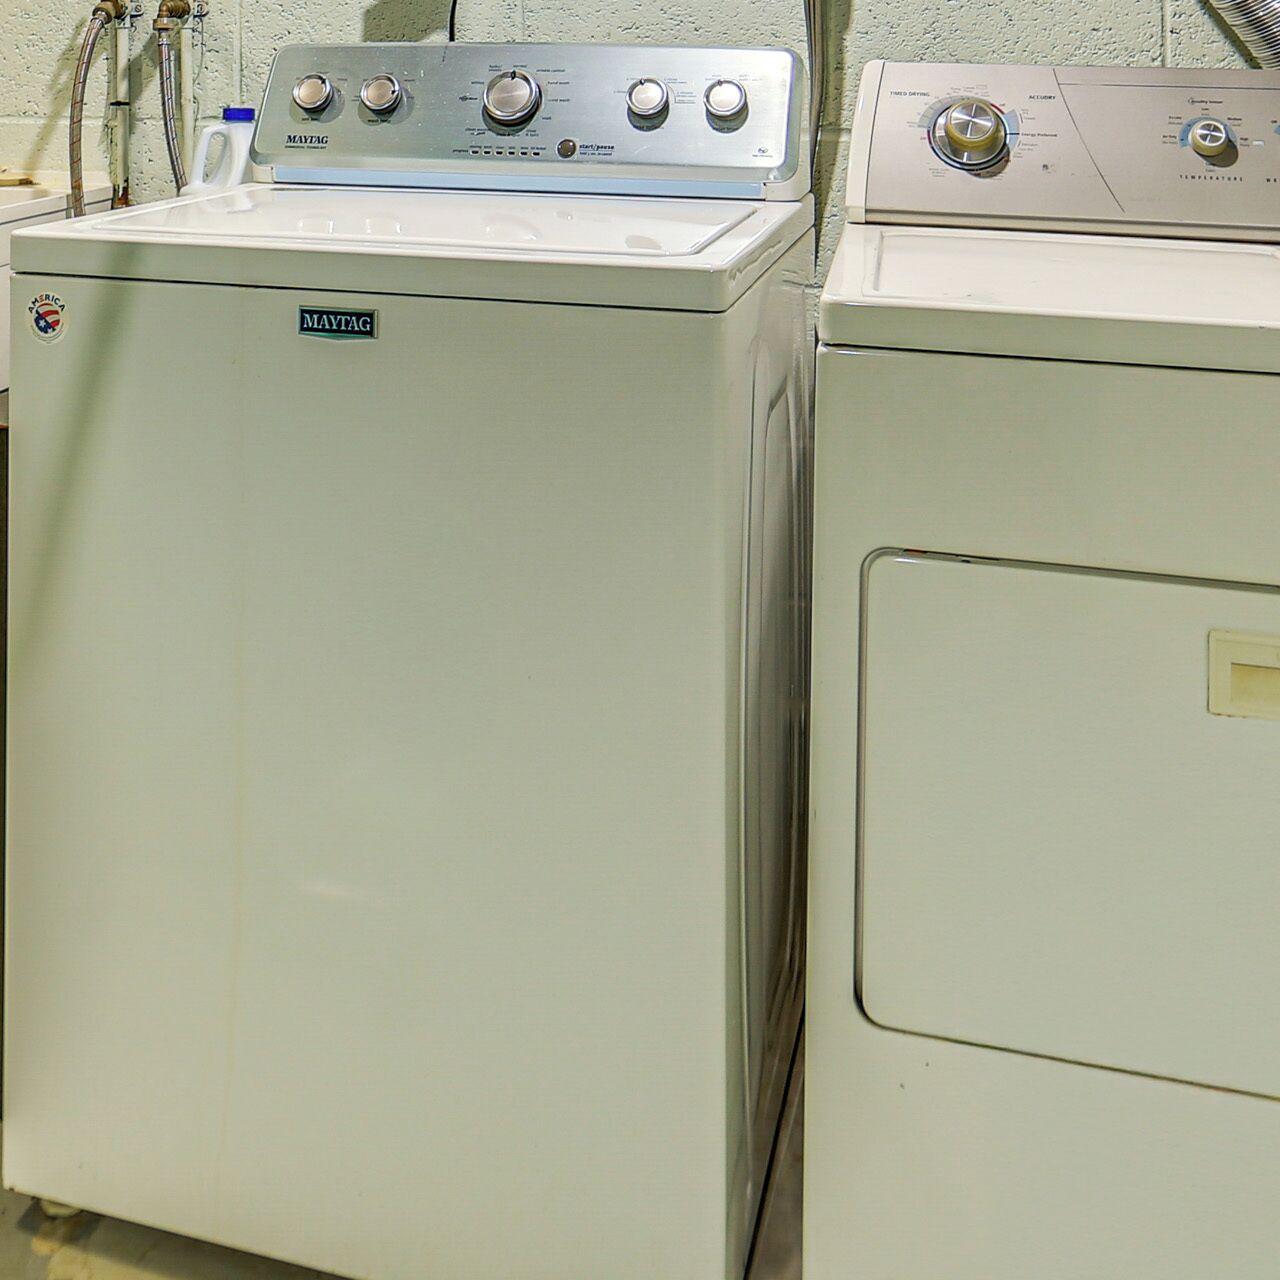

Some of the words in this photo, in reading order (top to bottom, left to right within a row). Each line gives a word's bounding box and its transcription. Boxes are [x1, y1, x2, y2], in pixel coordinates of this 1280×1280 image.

[286, 135, 329, 144] MAYTAG
[1179, 174, 1243, 182] TEMPERATURE
[28, 293, 65, 314] AMERICA
[303, 313, 371, 332] MAYTAG
